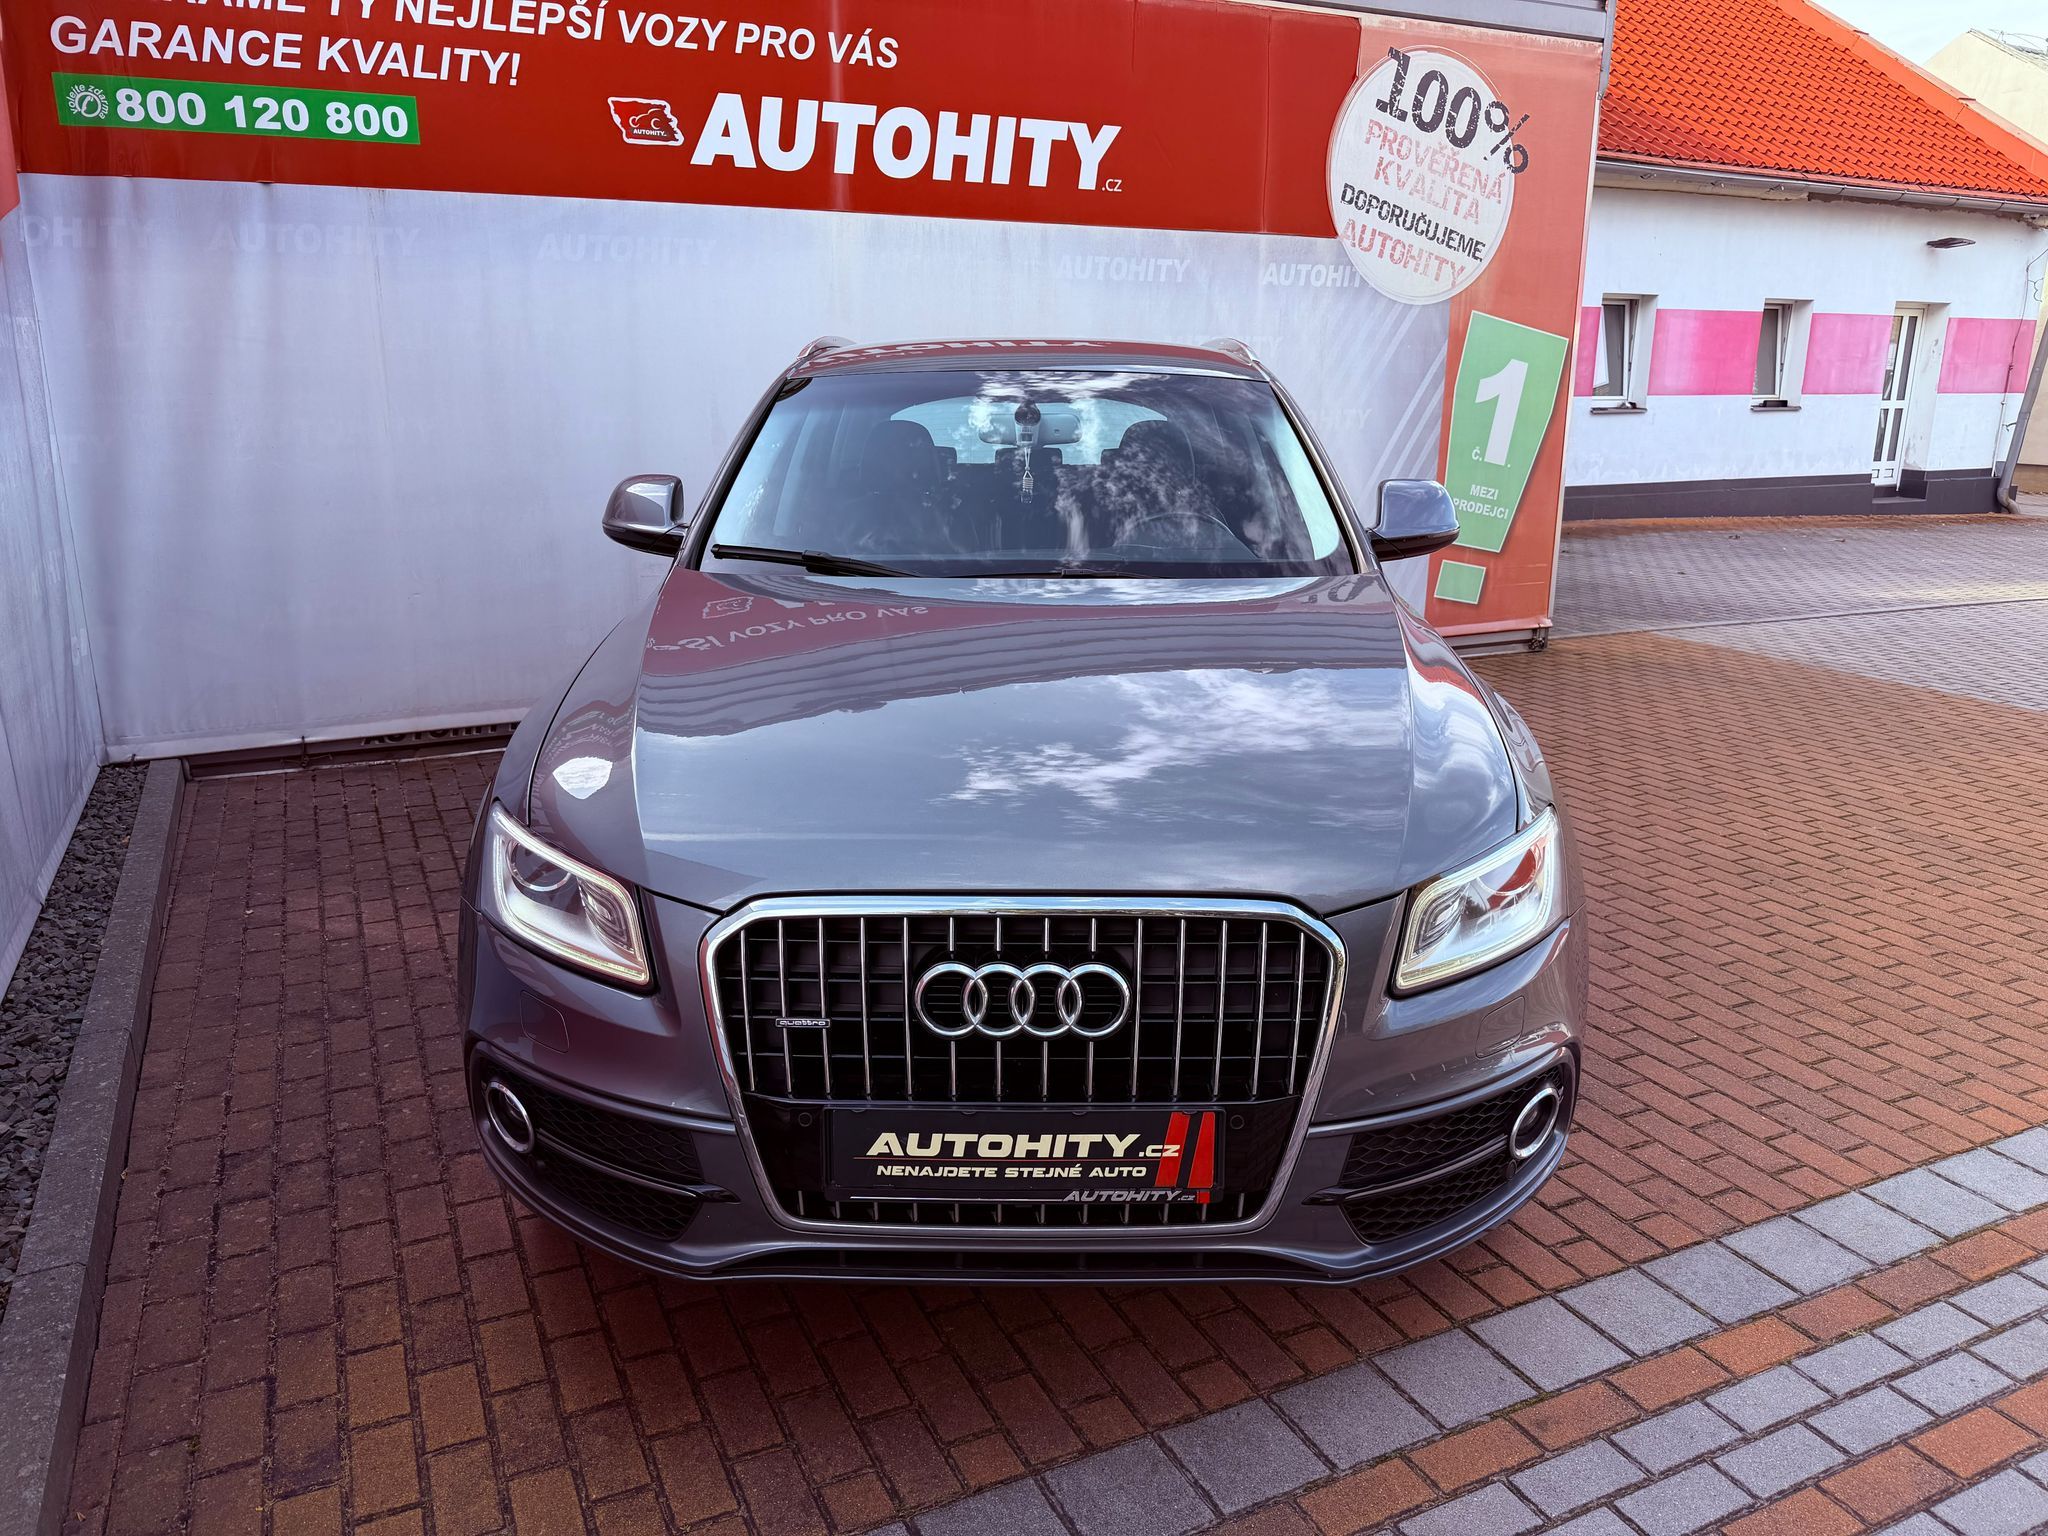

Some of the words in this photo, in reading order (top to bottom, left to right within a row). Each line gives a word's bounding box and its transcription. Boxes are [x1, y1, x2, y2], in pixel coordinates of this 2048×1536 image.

[50, 15, 302, 69] GARANCE
[317, 36, 521, 87] KVALITY!
[394, 0, 609, 41] NEJLEPŠÍ
[618, 12, 728, 53] VOZY
[735, 24, 816, 60] PRO
[827, 28, 899, 69] VÁS
[66, 84, 86, 114] volejte
[88, 84, 109, 120] zdarma
[115, 88, 207, 126] 800
[224, 95, 309, 131] 120
[325, 101, 409, 137] 800
[1376, 46, 1530, 174] 100%
[1364, 118, 1506, 205] PROVĚŘENÁ
[1374, 156, 1480, 225] KVALITA
[1340, 182, 1486, 262] DOPORUČUJEME
[1342, 218, 1466, 289] AUTOHITY
[1056, 254, 1190, 284] AUTOHITY
[1453, 498, 1509, 519] PRODEJCI
[1470, 484, 1499, 500] MEZI
[876, 1165, 998, 1177] NENAJDETE
[1004, 1164, 1082, 1178] STEJNÉ
[1088, 1166, 1147, 1177] AUTO
